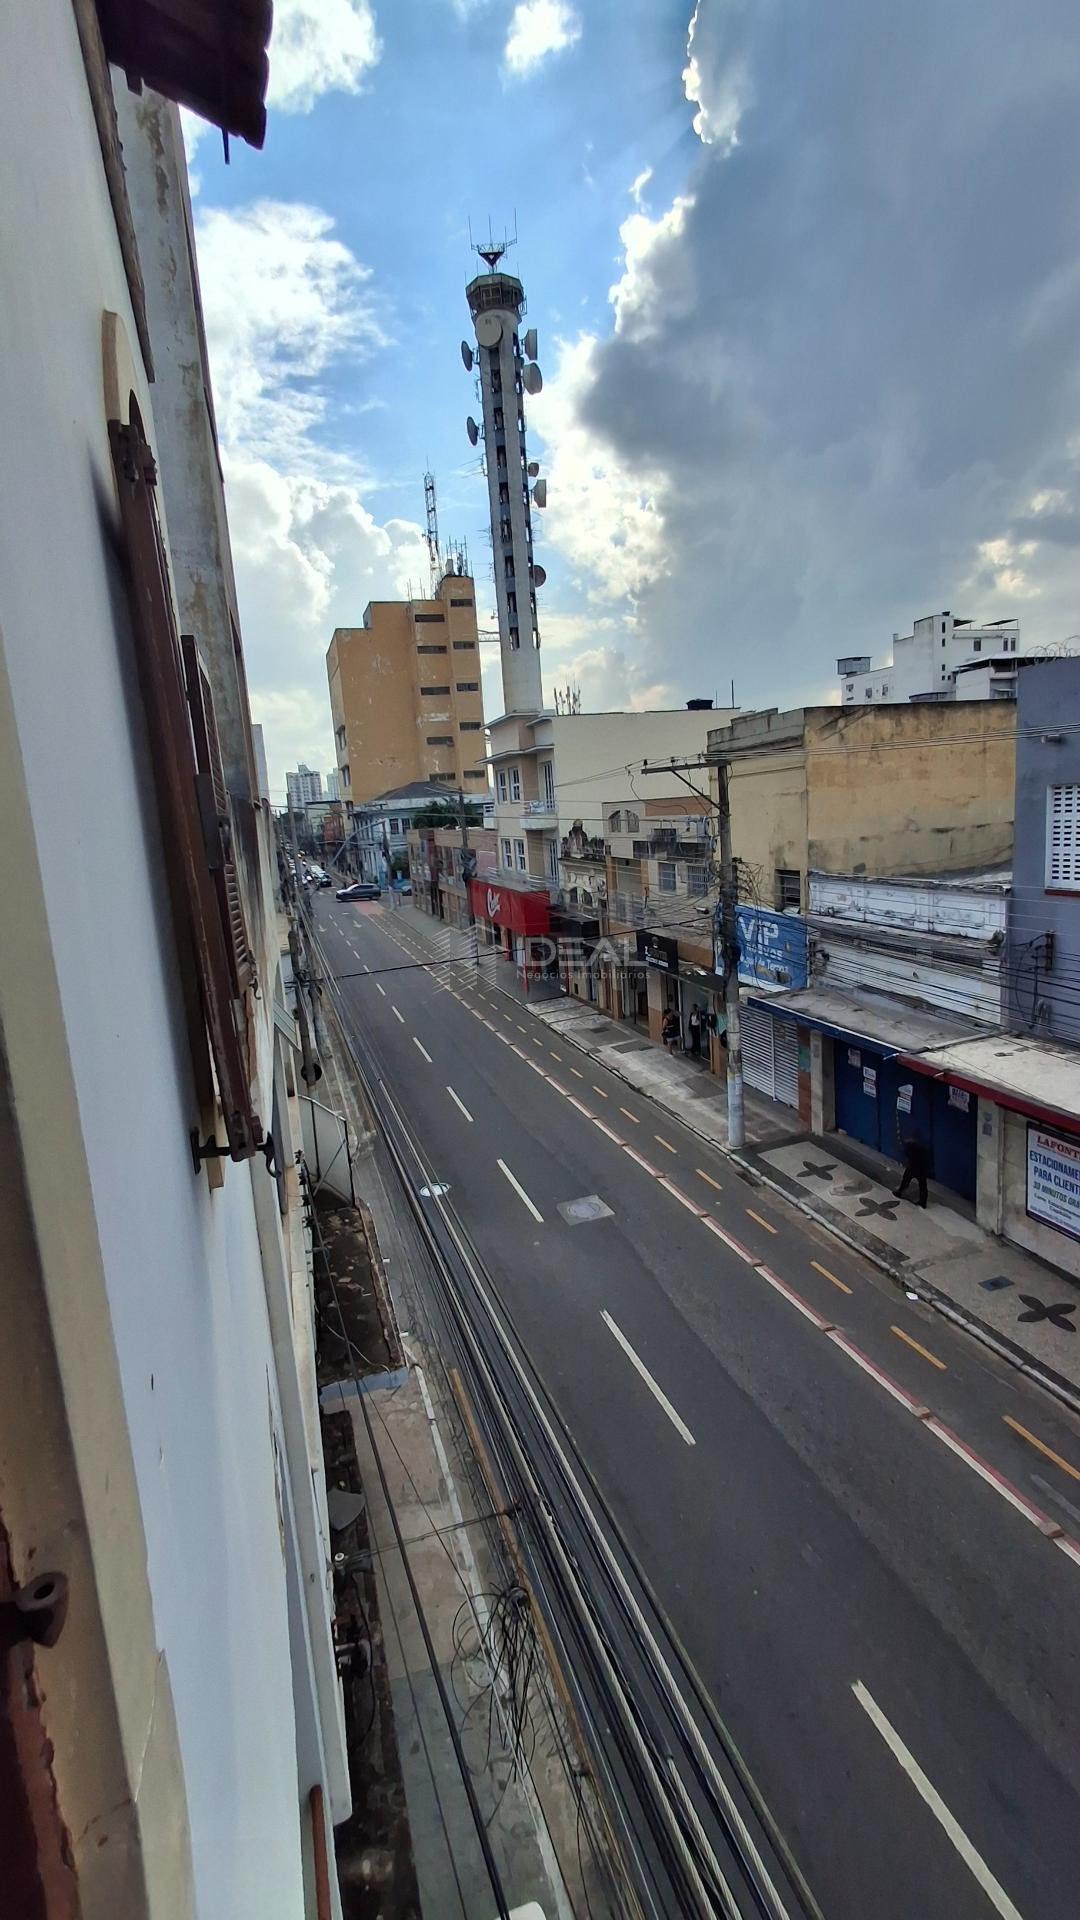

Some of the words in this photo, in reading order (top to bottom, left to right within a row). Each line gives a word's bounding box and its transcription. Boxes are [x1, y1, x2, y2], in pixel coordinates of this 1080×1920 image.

[1037, 1135, 1080, 1159] LAFONT
[1030, 1150, 1080, 1181] ESTACIONAME
[1033, 1166, 1052, 1183] PARA
[1054, 1174, 1080, 1196] CLIENT
